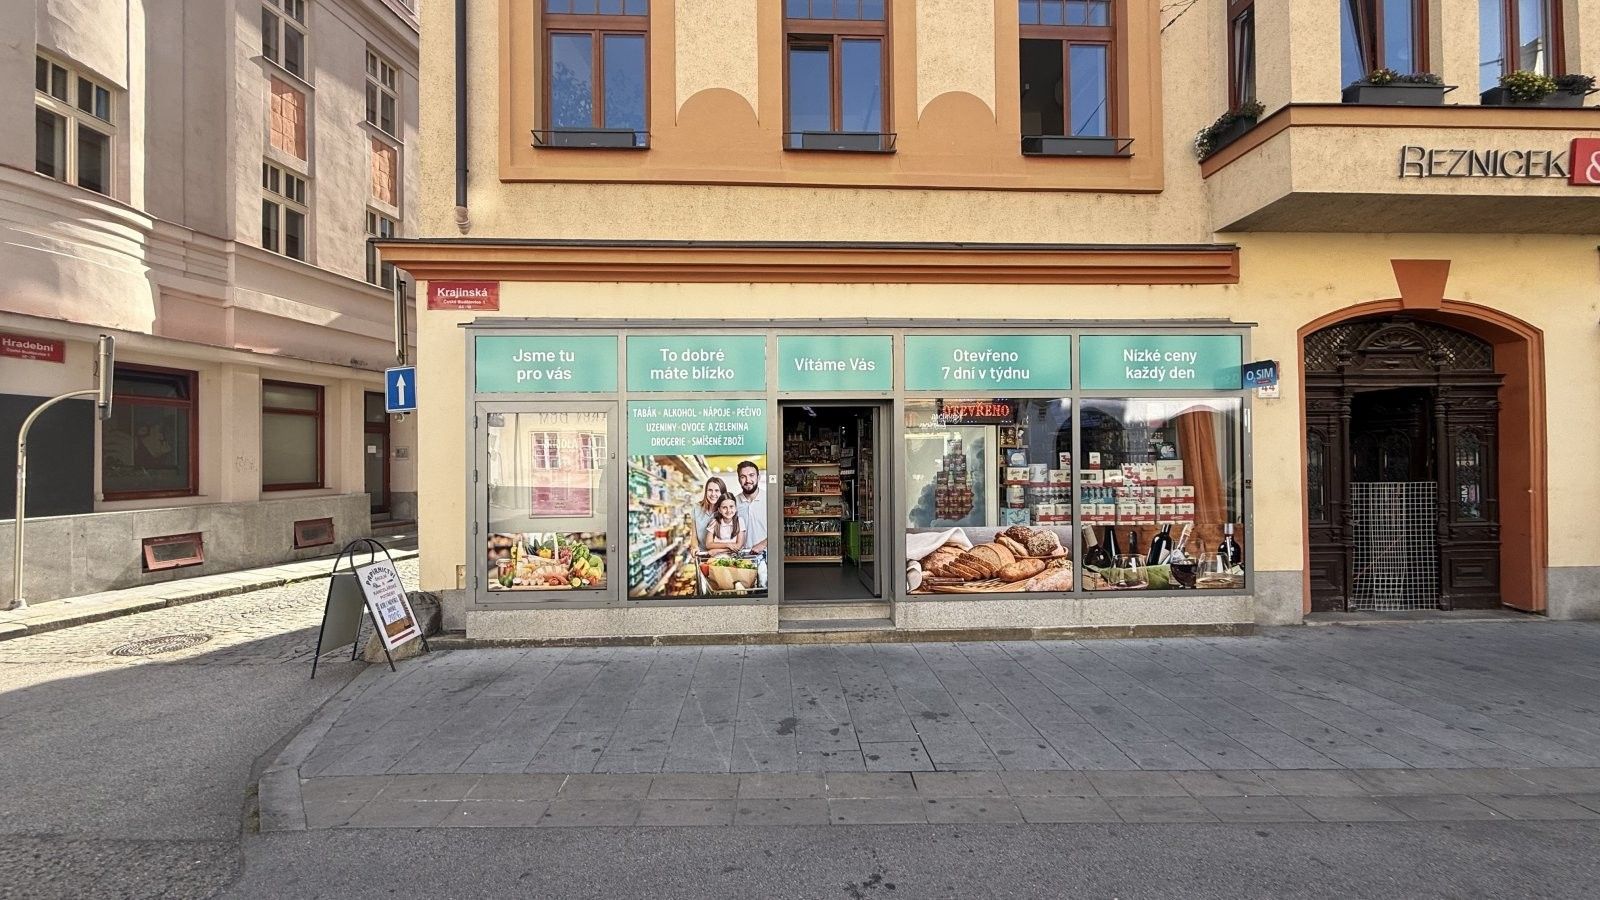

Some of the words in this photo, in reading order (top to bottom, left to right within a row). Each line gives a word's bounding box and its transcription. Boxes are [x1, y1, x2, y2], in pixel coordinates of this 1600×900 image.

[1399, 145, 1567, 178] REZNICEK
[437, 287, 488, 298] Krajinská
[512, 349, 555, 362] Jsme
[559, 350, 575, 362] tu
[659, 348, 678, 361] To
[681, 348, 725, 361] dobré
[953, 348, 1019, 362] Otevřeno
[1123, 349, 1161, 362] Nízké
[1164, 351, 1198, 365] ceny
[794, 357, 846, 371] Vítáme
[849, 357, 876, 371] Vás
[516, 369, 543, 383] pro
[546, 367, 572, 380] vás
[650, 367, 689, 380] máte
[692, 366, 735, 380] blízko
[941, 366, 951, 379] 7
[953, 366, 975, 379] dní
[978, 369, 987, 379] v
[990, 366, 1030, 382] týdnu
[1125, 366, 1166, 382] každý
[1169, 366, 1195, 379] den
[1256, 367, 1274, 380] SIM
[632, 405, 657, 418] TABÁK
[663, 408, 697, 418] ALKOHOL
[702, 405, 731, 417] NÁPOJE
[736, 405, 762, 417] PEČIVO
[943, 402, 1010, 417] OTEVŘENO
[646, 422, 677, 431] UZENINY
[681, 422, 705, 431] OVOCE
[708, 422, 714, 431] A
[714, 422, 749, 431] ZELENINA
[651, 437, 686, 446] DROGERIE
[691, 434, 722, 446] SMÍŠENÉ
[723, 434, 744, 446] ZBOŽÍ
